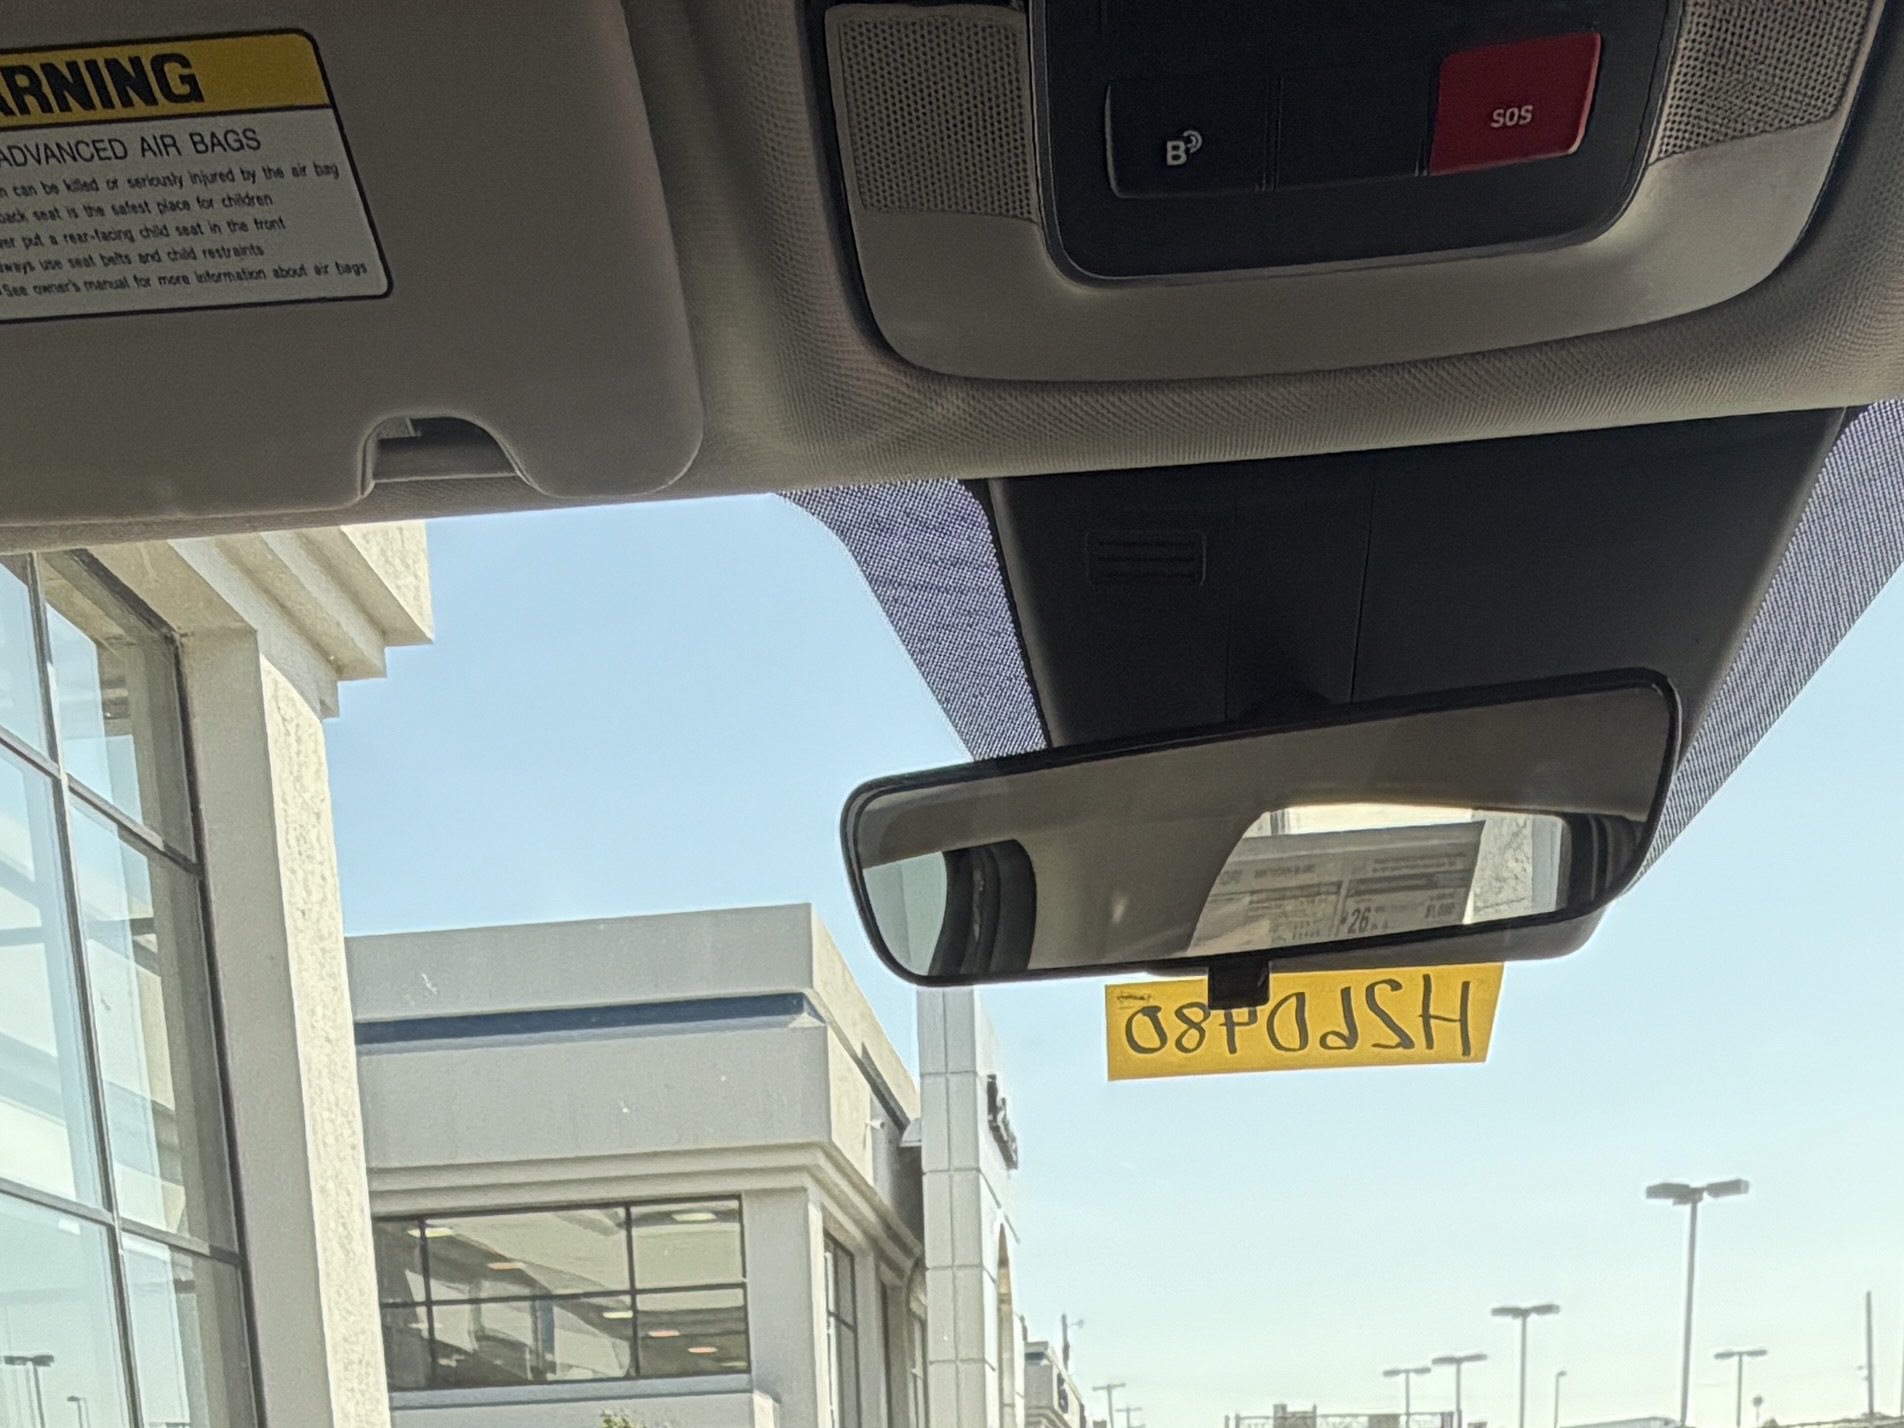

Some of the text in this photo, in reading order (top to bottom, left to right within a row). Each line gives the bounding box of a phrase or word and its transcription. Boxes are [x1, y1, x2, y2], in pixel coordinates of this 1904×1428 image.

[1489, 104, 1534, 129] SOS
[139, 134, 184, 159] AIR
[189, 127, 263, 156] BAGS
[13, 184, 37, 197] can
[40, 180, 60, 196] be
[62, 177, 100, 193] killed
[106, 178, 118, 191] or
[127, 172, 183, 190] seriously
[188, 168, 236, 186] injured
[239, 167, 257, 184] by
[261, 165, 286, 181] the
[291, 162, 308, 178] air
[312, 161, 340, 181] bag
[32, 206, 63, 222] seat
[66, 205, 79, 220] is
[82, 203, 106, 219] the
[110, 200, 153, 216] safest
[156, 198, 192, 216] place
[195, 195, 215, 210] for
[221, 193, 274, 209] children
[21, 233, 46, 251] put
[139, 224, 171, 239] child
[174, 222, 205, 237] seat
[208, 219, 223, 235] in
[226, 219, 250, 234] the
[253, 215, 287, 230] front
[39, 259, 64, 272] use
[66, 254, 97, 269] seat
[99, 250, 133, 268] belts
[138, 249, 163, 265] and
[166, 246, 198, 262] child
[202, 243, 265, 260] restraints
[2, 283, 29, 298] See
[83, 274, 132, 291] manual
[133, 273, 152, 289] for
[158, 273, 192, 287] more
[196, 266, 267, 285] information
[272, 263, 308, 280] about
[312, 262, 330, 276] air
[335, 259, 369, 278] bags
